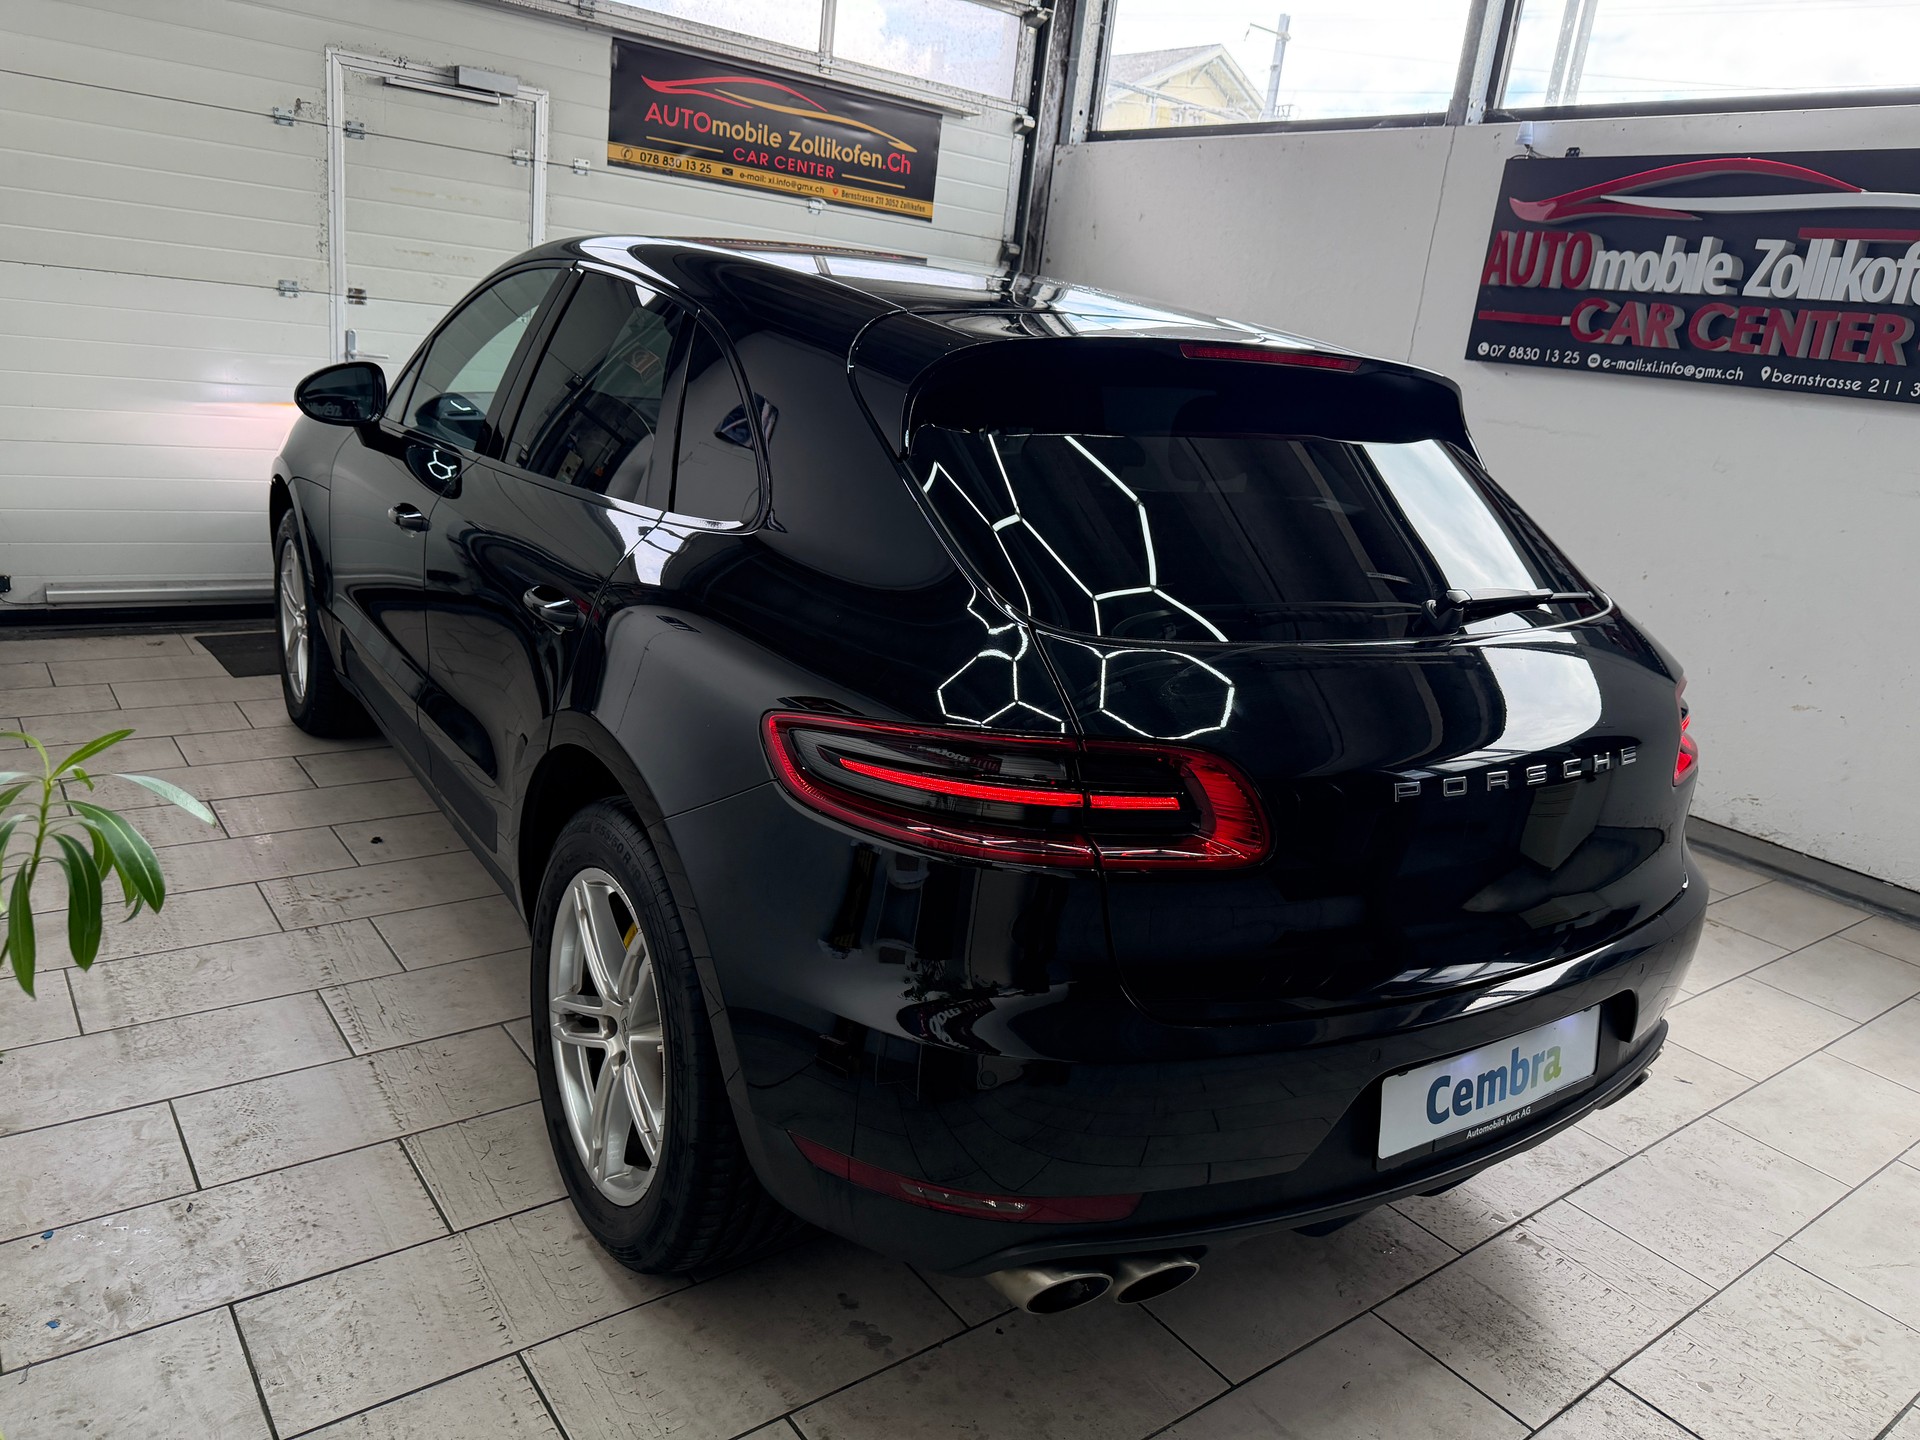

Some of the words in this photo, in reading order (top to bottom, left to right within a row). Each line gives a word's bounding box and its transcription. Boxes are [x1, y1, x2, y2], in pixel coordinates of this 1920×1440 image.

[640, 152, 659, 164] 078
[662, 156, 682, 168] 830
[686, 160, 696, 171] 13
[699, 162, 712, 174] 25
[644, 102, 783, 149] AUTOmobile
[788, 130, 912, 175] Zollikofen.Ch
[733, 147, 769, 166] CAR
[774, 155, 836, 179] CENTER
[1480, 230, 1744, 296] AUTOmobile
[1569, 297, 1684, 350] CAR
[1688, 302, 1917, 367] CENTER
[1490, 344, 1506, 357] 07
[1508, 346, 1540, 361] 8830
[1545, 349, 1559, 363] 13
[1563, 350, 1580, 365] 25
[1771, 371, 1863, 391] bernstrasse
[1867, 377, 1902, 396] 211
[1394, 745, 1638, 802] PORSCHE
[1426, 1045, 1562, 1125] Cembra
[1466, 1118, 1505, 1139] Automobile
[1505, 1110, 1520, 1124] Kurt
[1520, 1105, 1531, 1119] AG
